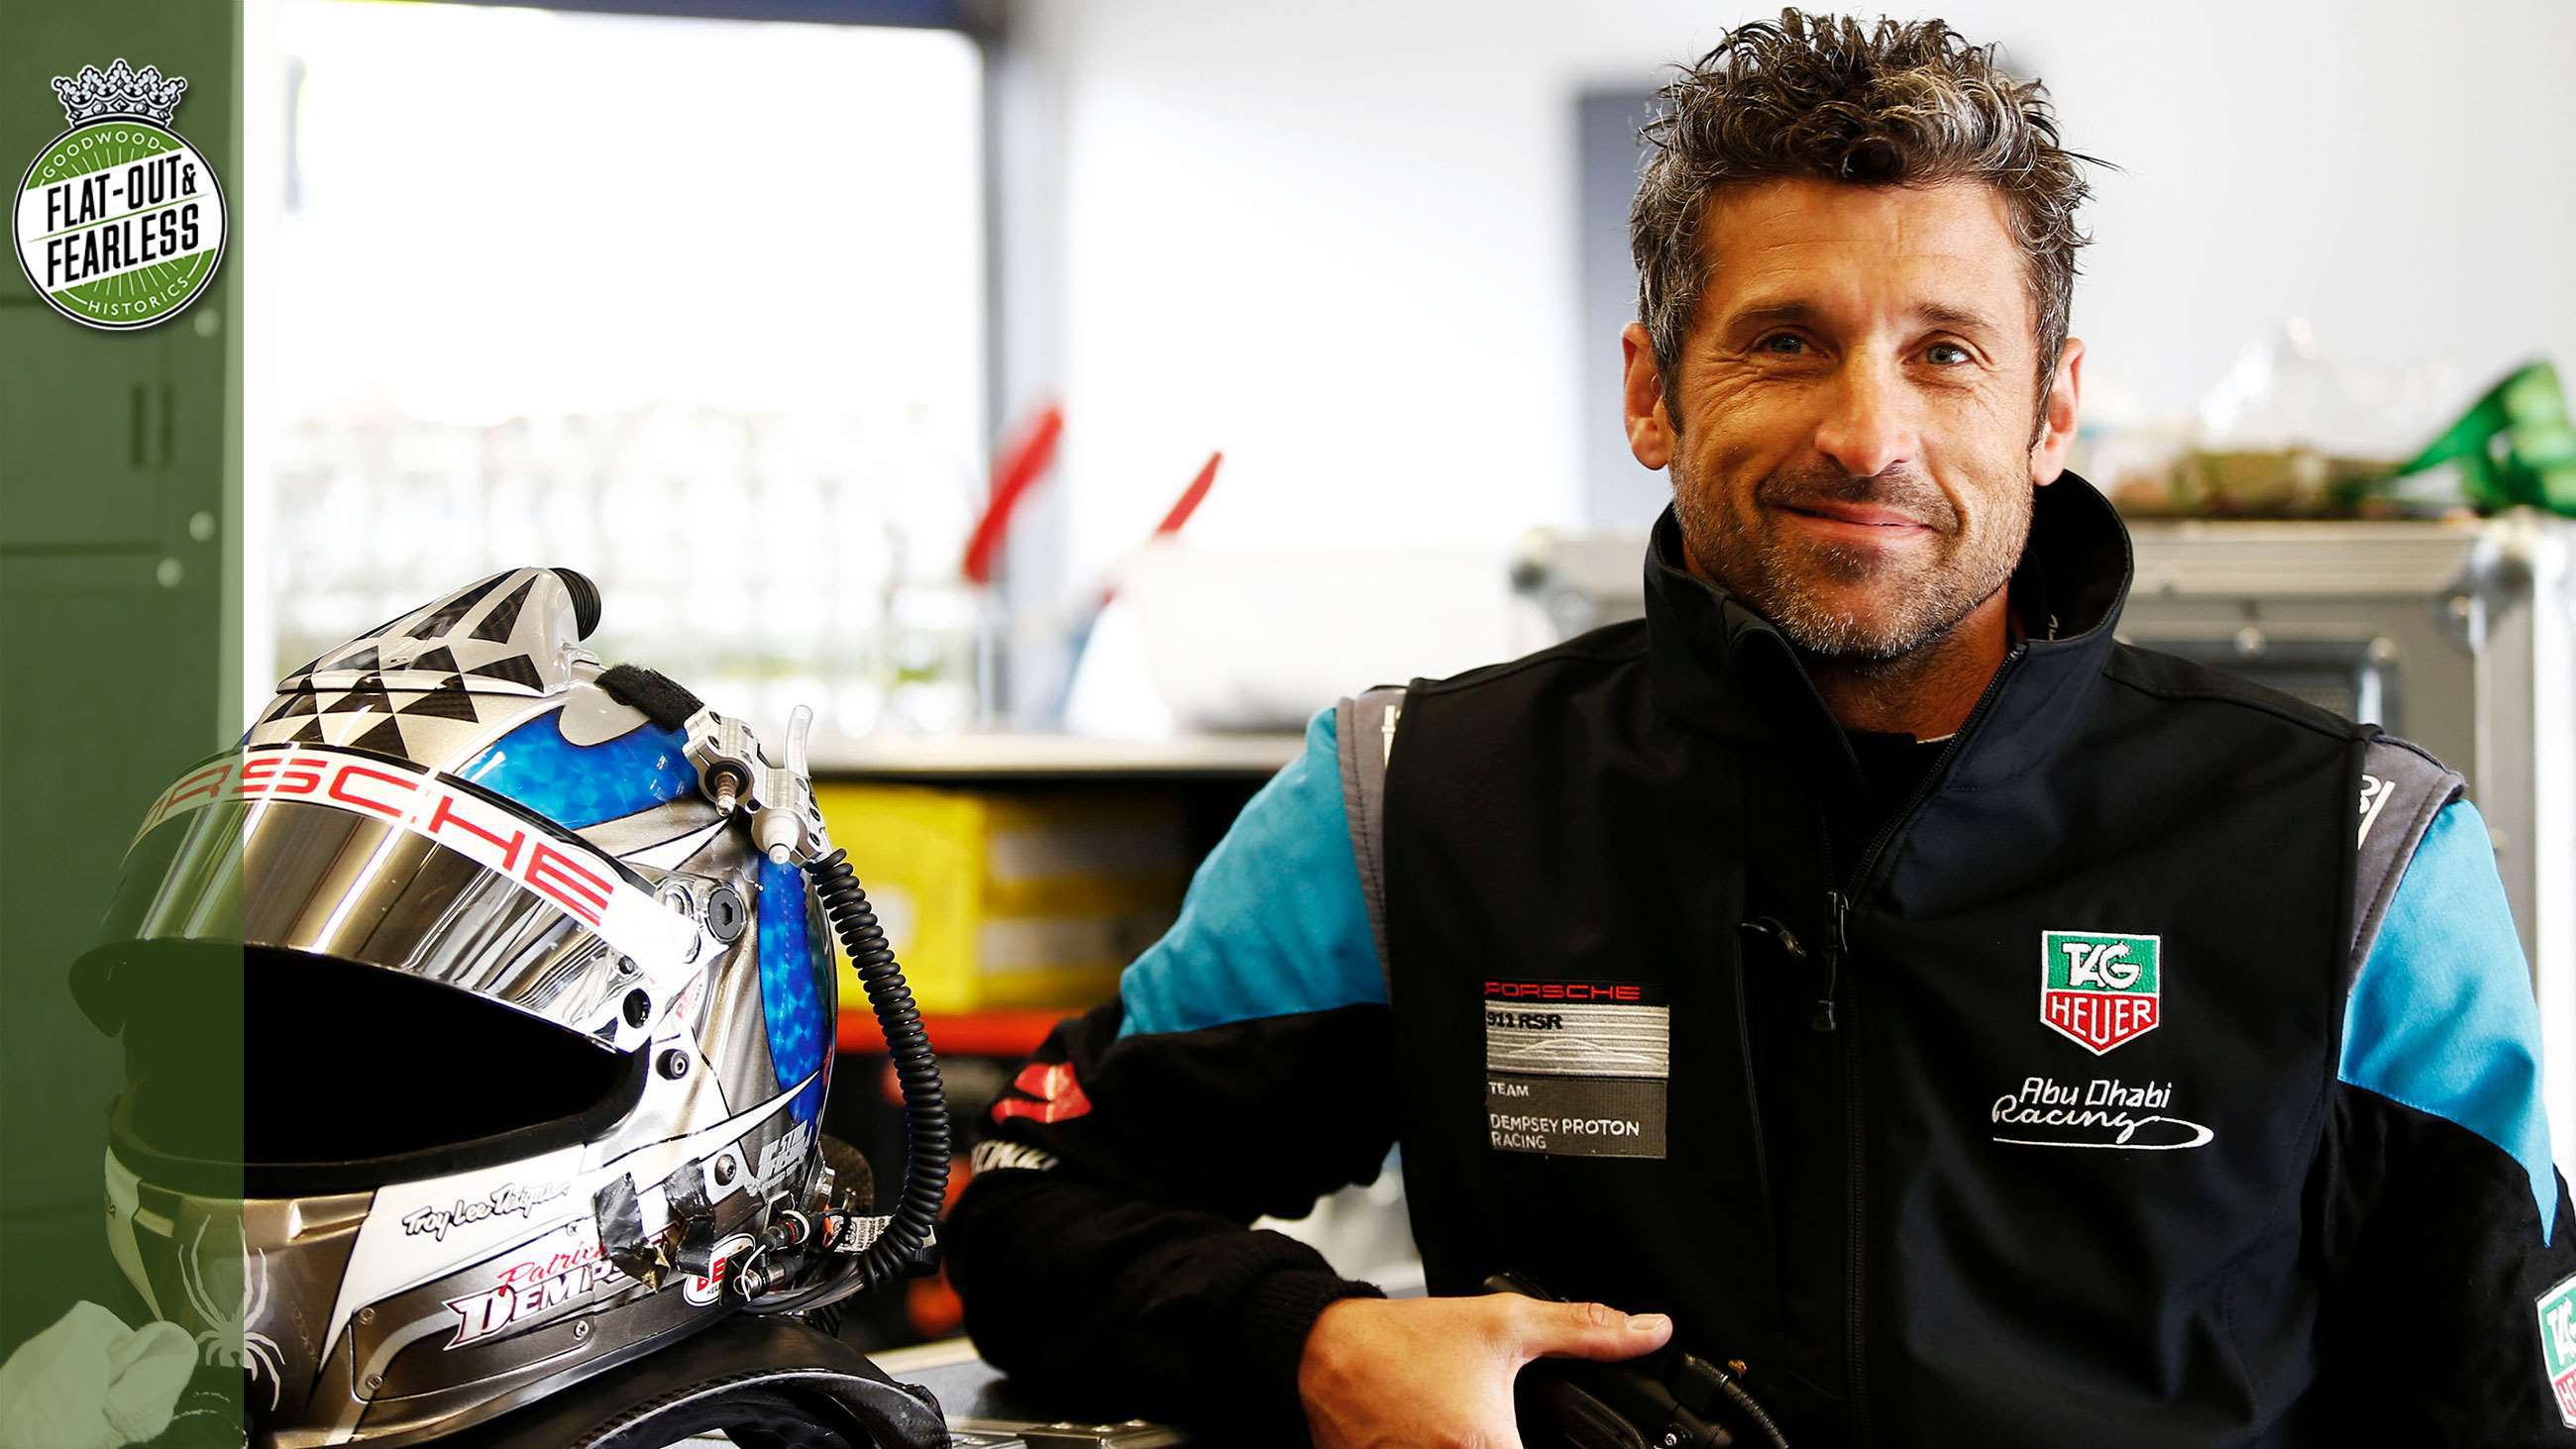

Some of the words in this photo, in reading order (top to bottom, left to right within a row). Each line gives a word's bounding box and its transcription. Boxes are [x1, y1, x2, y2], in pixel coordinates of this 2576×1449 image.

[134, 758, 614, 927] RSCHE
[2061, 940, 2142, 990] TAG
[1484, 982, 1641, 1000] PORSCHE
[1487, 1011, 1515, 1028] 911
[1518, 1013, 1563, 1030] RSR
[2051, 995, 2152, 1045] HEUER
[1488, 1082, 1529, 1096] TEAM
[2019, 1077, 2079, 1106] Abu
[2085, 1079, 2172, 1108] Dhabi
[1490, 1113, 1558, 1134] DEMPSEY
[1561, 1118, 1640, 1136] PROTON
[1991, 1093, 2138, 1145] Racing
[1491, 1132, 1547, 1150] RACING
[402, 1205, 450, 1242] Troy
[451, 1199, 492, 1227] Lee
